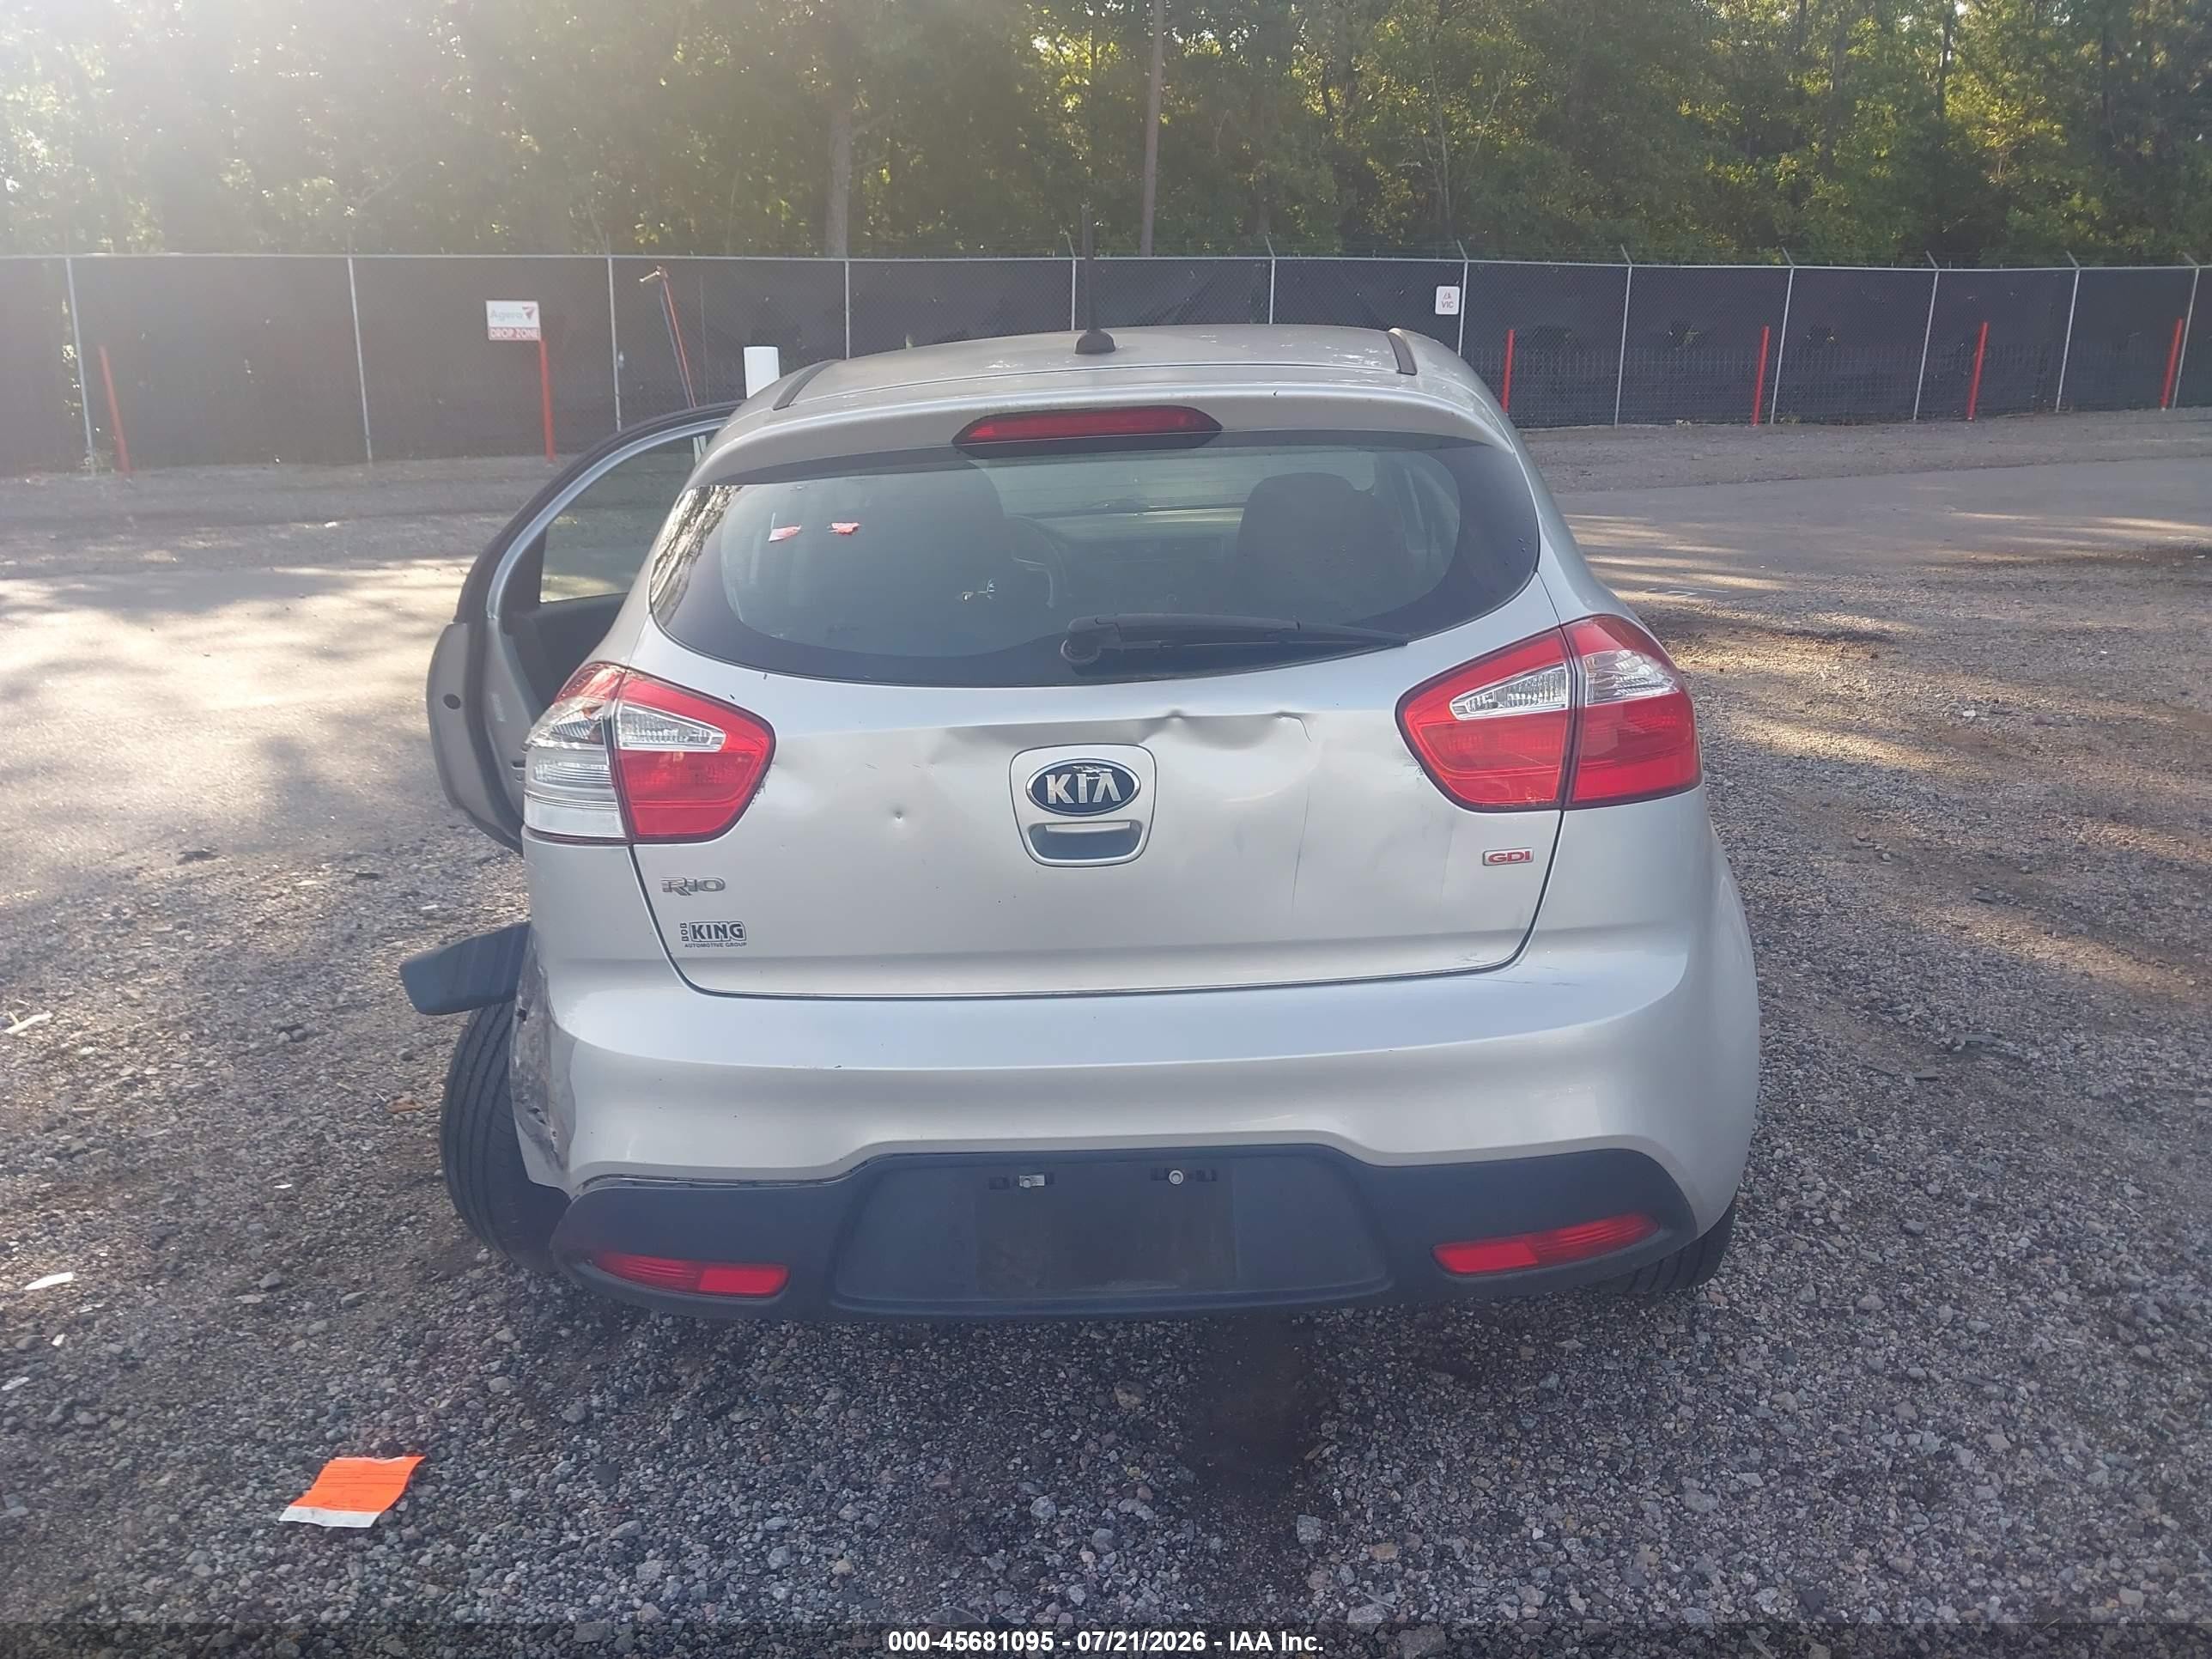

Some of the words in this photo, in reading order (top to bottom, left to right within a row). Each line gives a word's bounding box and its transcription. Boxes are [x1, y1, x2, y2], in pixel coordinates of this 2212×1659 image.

[490, 328, 515, 337] DROP
[516, 328, 538, 337] ZONE
[1045, 773, 1121, 804] KIA
[1488, 850, 1530, 863] GDI
[660, 877, 726, 896] RIO
[680, 922, 690, 942] BOB
[690, 922, 745, 941] KING
